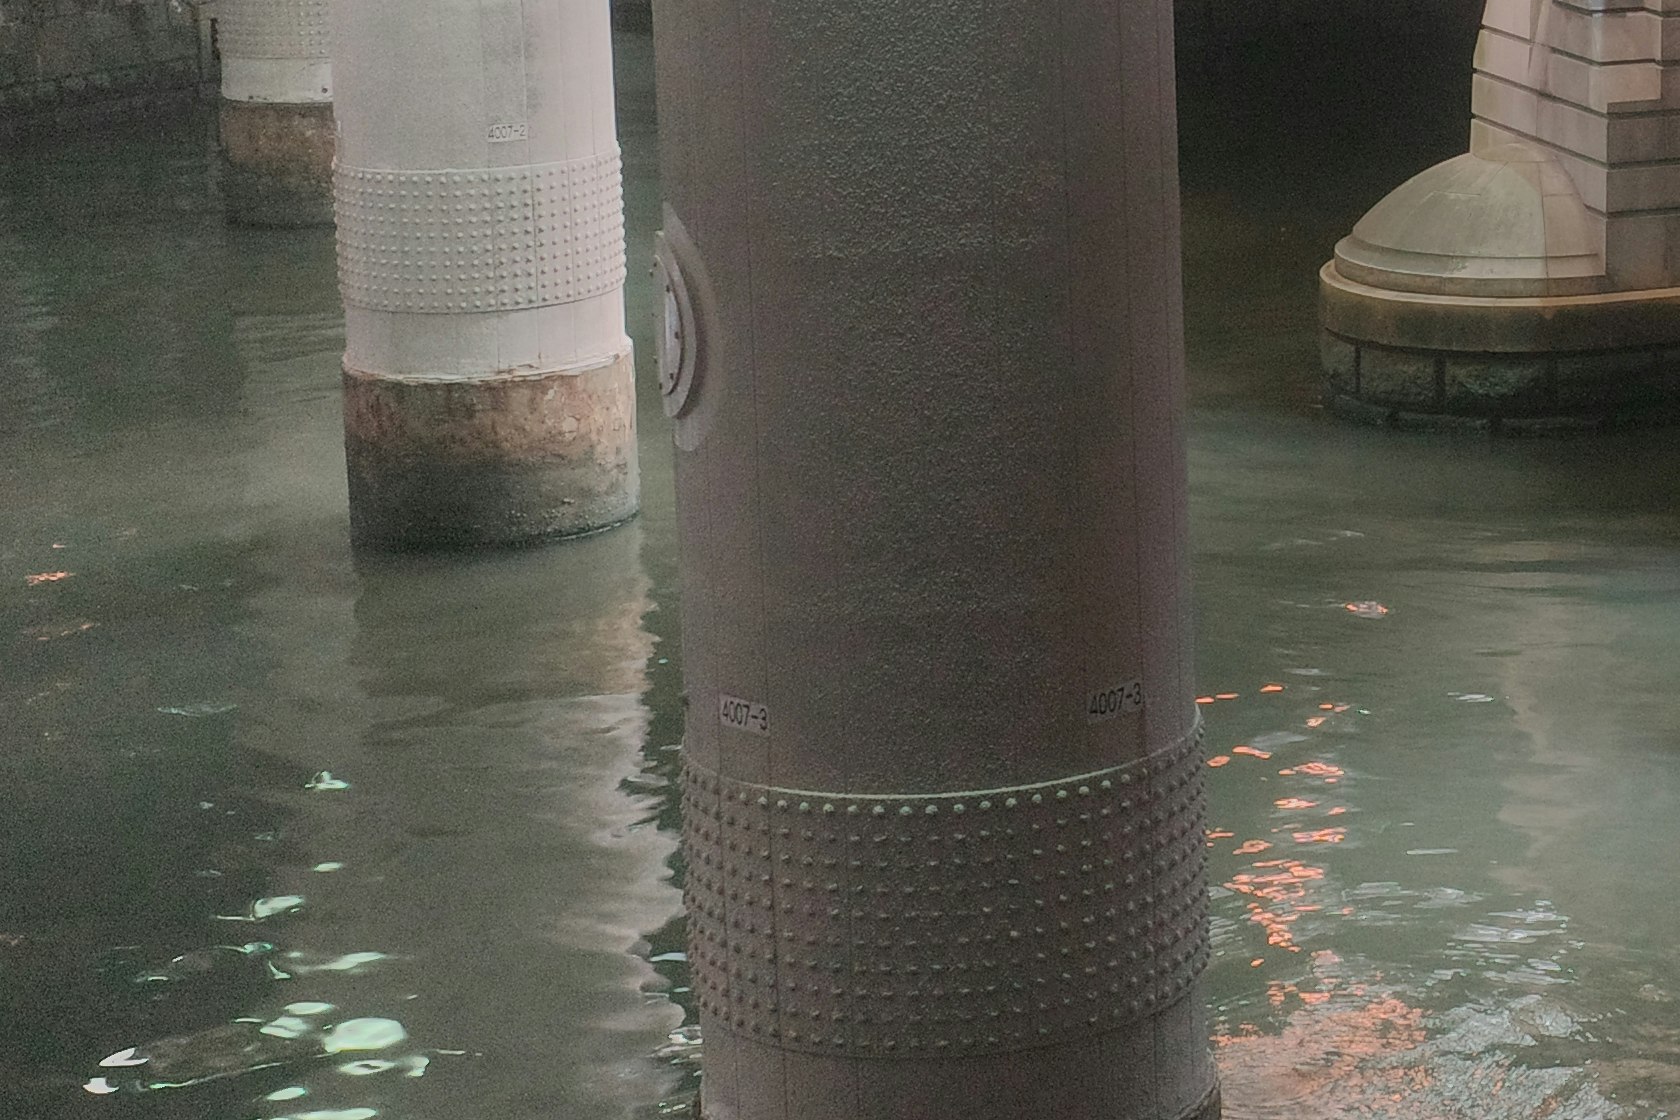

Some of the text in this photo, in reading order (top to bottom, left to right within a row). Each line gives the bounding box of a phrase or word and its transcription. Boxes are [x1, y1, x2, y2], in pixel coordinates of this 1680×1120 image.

[488, 124, 526, 139] 4007-2
[1089, 682, 1142, 716] 4007-3
[722, 700, 768, 731] 4007-3
